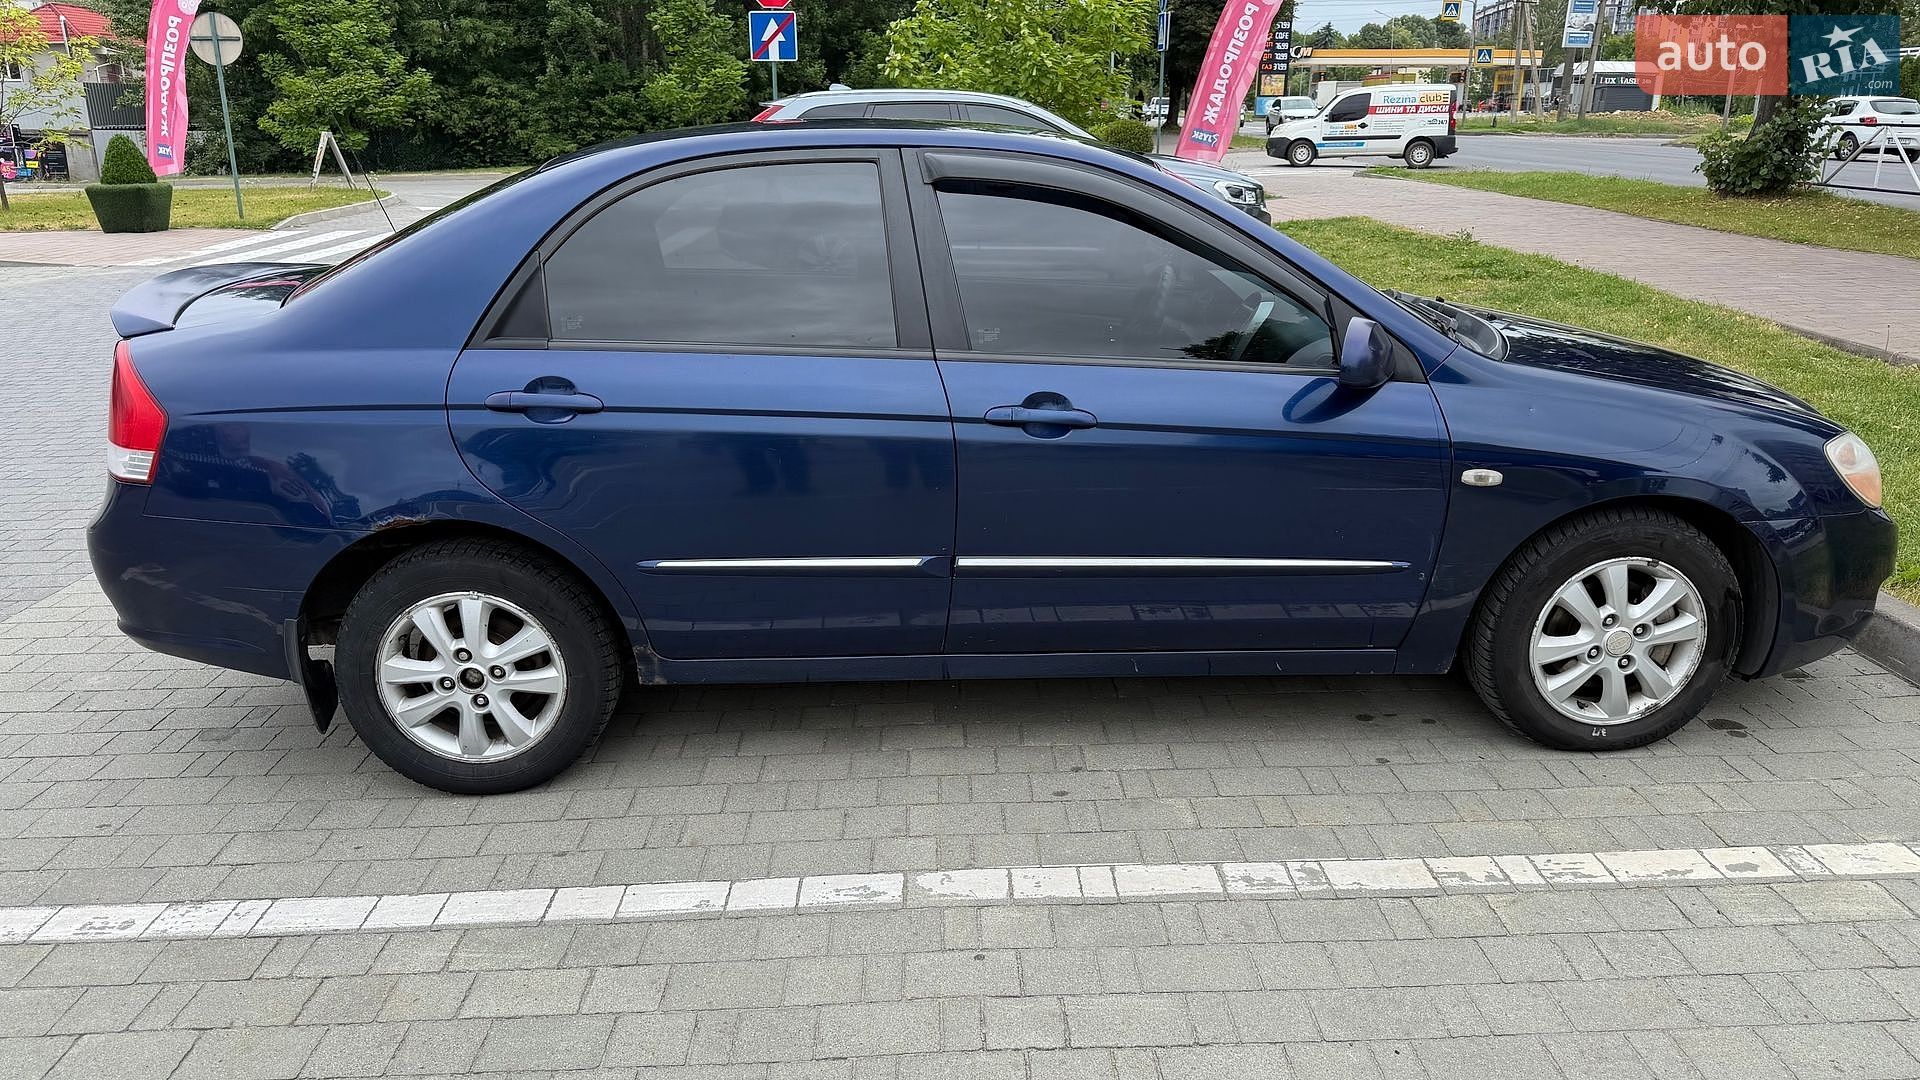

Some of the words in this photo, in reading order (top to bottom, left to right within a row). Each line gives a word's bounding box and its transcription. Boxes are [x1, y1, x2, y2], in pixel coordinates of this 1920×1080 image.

[1383, 95, 1417, 104] Rezina
[1419, 92, 1442, 103] club
[1376, 106, 1404, 114] ШИНИ
[1417, 104, 1449, 114] ДИСКИ
